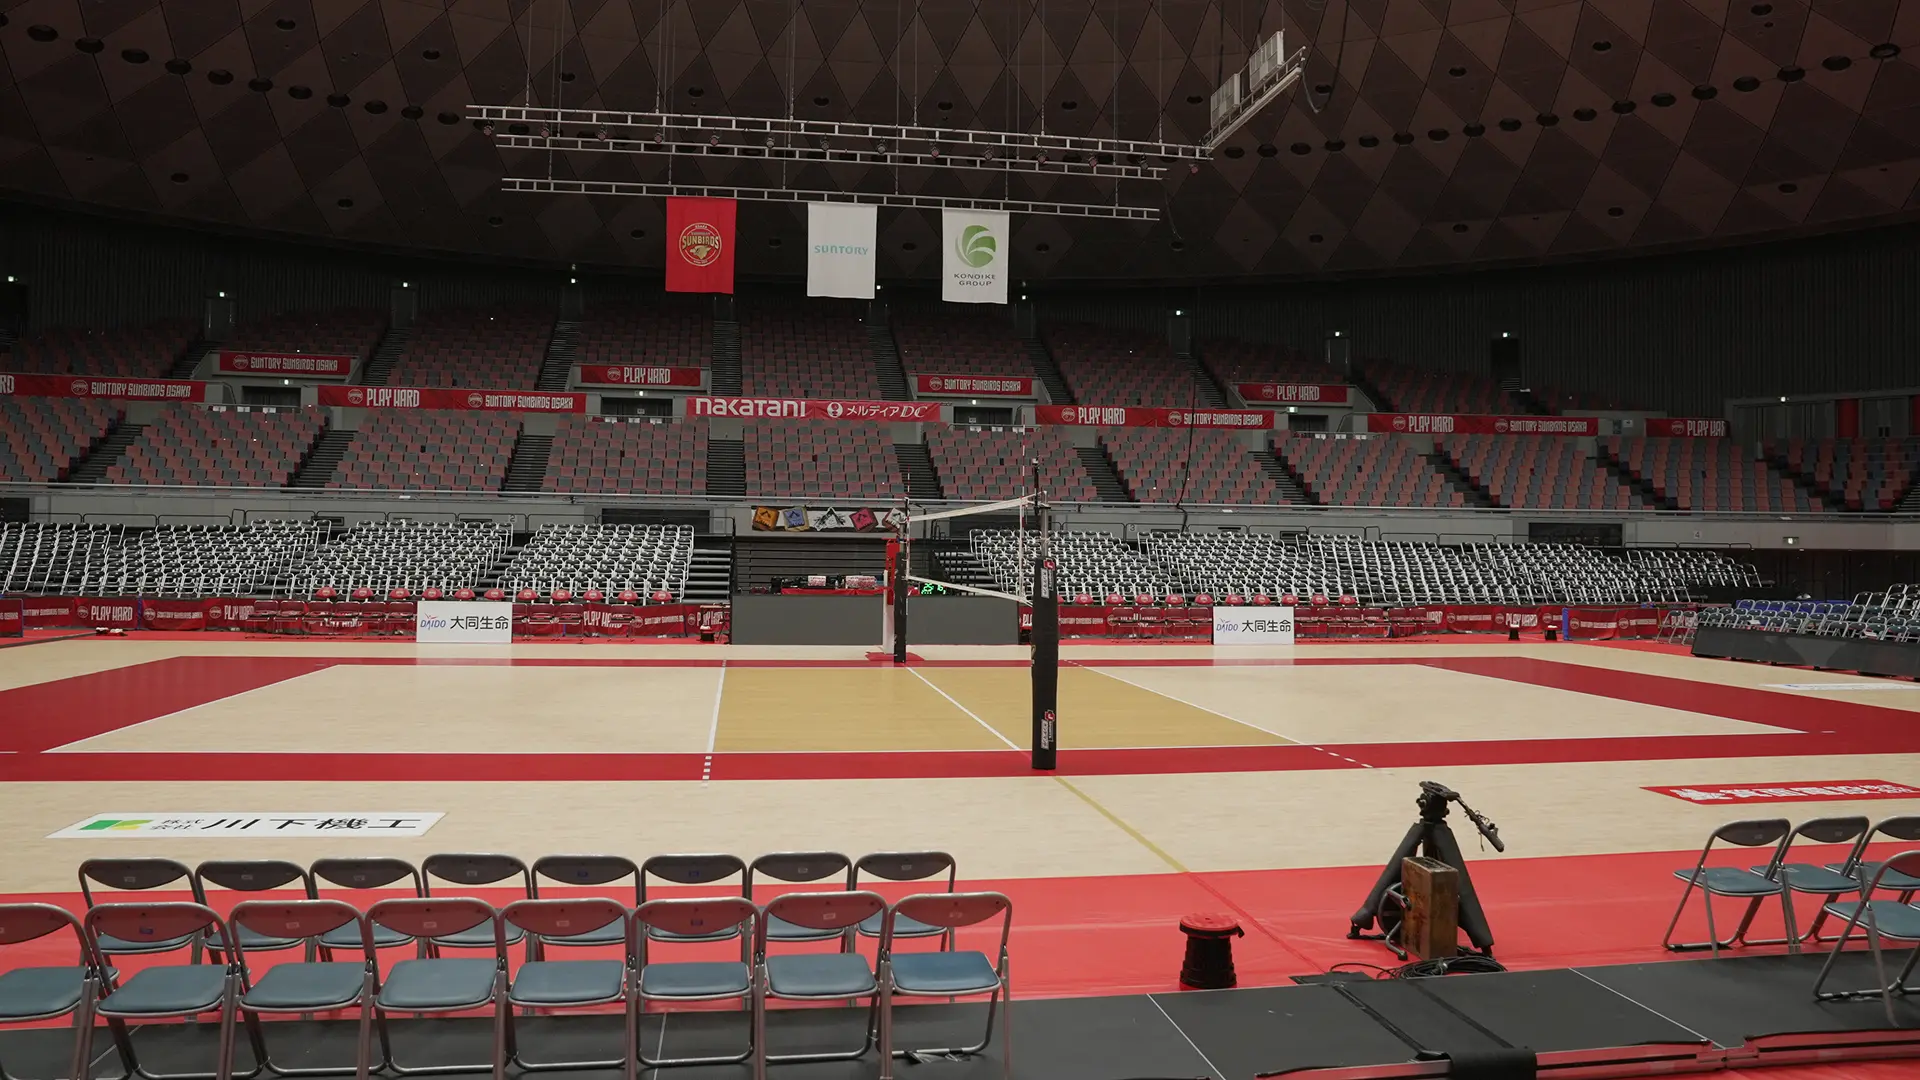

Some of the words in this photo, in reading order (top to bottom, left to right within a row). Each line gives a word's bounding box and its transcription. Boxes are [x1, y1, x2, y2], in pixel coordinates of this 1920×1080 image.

[682, 235, 719, 250] SUNBIRDS
[814, 245, 869, 256] SUNTORY
[953, 273, 996, 281] KONOIKE
[250, 357, 281, 368] SUNTORY
[282, 358, 315, 370] SUNBIRDS
[316, 360, 338, 371] OSAKA
[624, 367, 646, 384] PLAY
[647, 367, 670, 384] HARD
[91, 382, 126, 396] SUNTORY
[127, 383, 164, 397] SUNBIRDS
[165, 385, 191, 398] OSAKA
[1277, 386, 1297, 401] PLAY
[1298, 386, 1320, 401] HARD
[366, 389, 391, 407] PLAY
[393, 390, 420, 408] HARD
[485, 394, 516, 407] SUNTORY
[517, 395, 550, 409] SUNBIRDS
[551, 397, 573, 409] OSAKA
[1078, 407, 1101, 424] PLAY
[1102, 407, 1127, 425] HARD
[1212, 413, 1242, 426] SUNBIRDS
[1408, 416, 1430, 432] PLAY
[1431, 416, 1454, 432] HARD
[1510, 420, 1537, 432] SUNTORY
[1538, 420, 1567, 432] SUNBIRDS
[1687, 420, 1709, 436] PLAY
[91, 605, 111, 621] PLAY
[112, 606, 133, 621] HARD
[223, 605, 238, 620] PLAY
[583, 610, 601, 626] PLAY
[420, 619, 446, 630] DAIDO
[450, 615, 509, 630] 大同生命
[1216, 622, 1239, 633] DAIDO
[1242, 619, 1292, 633] 大同生命
[201, 818, 421, 830] 川下機工
